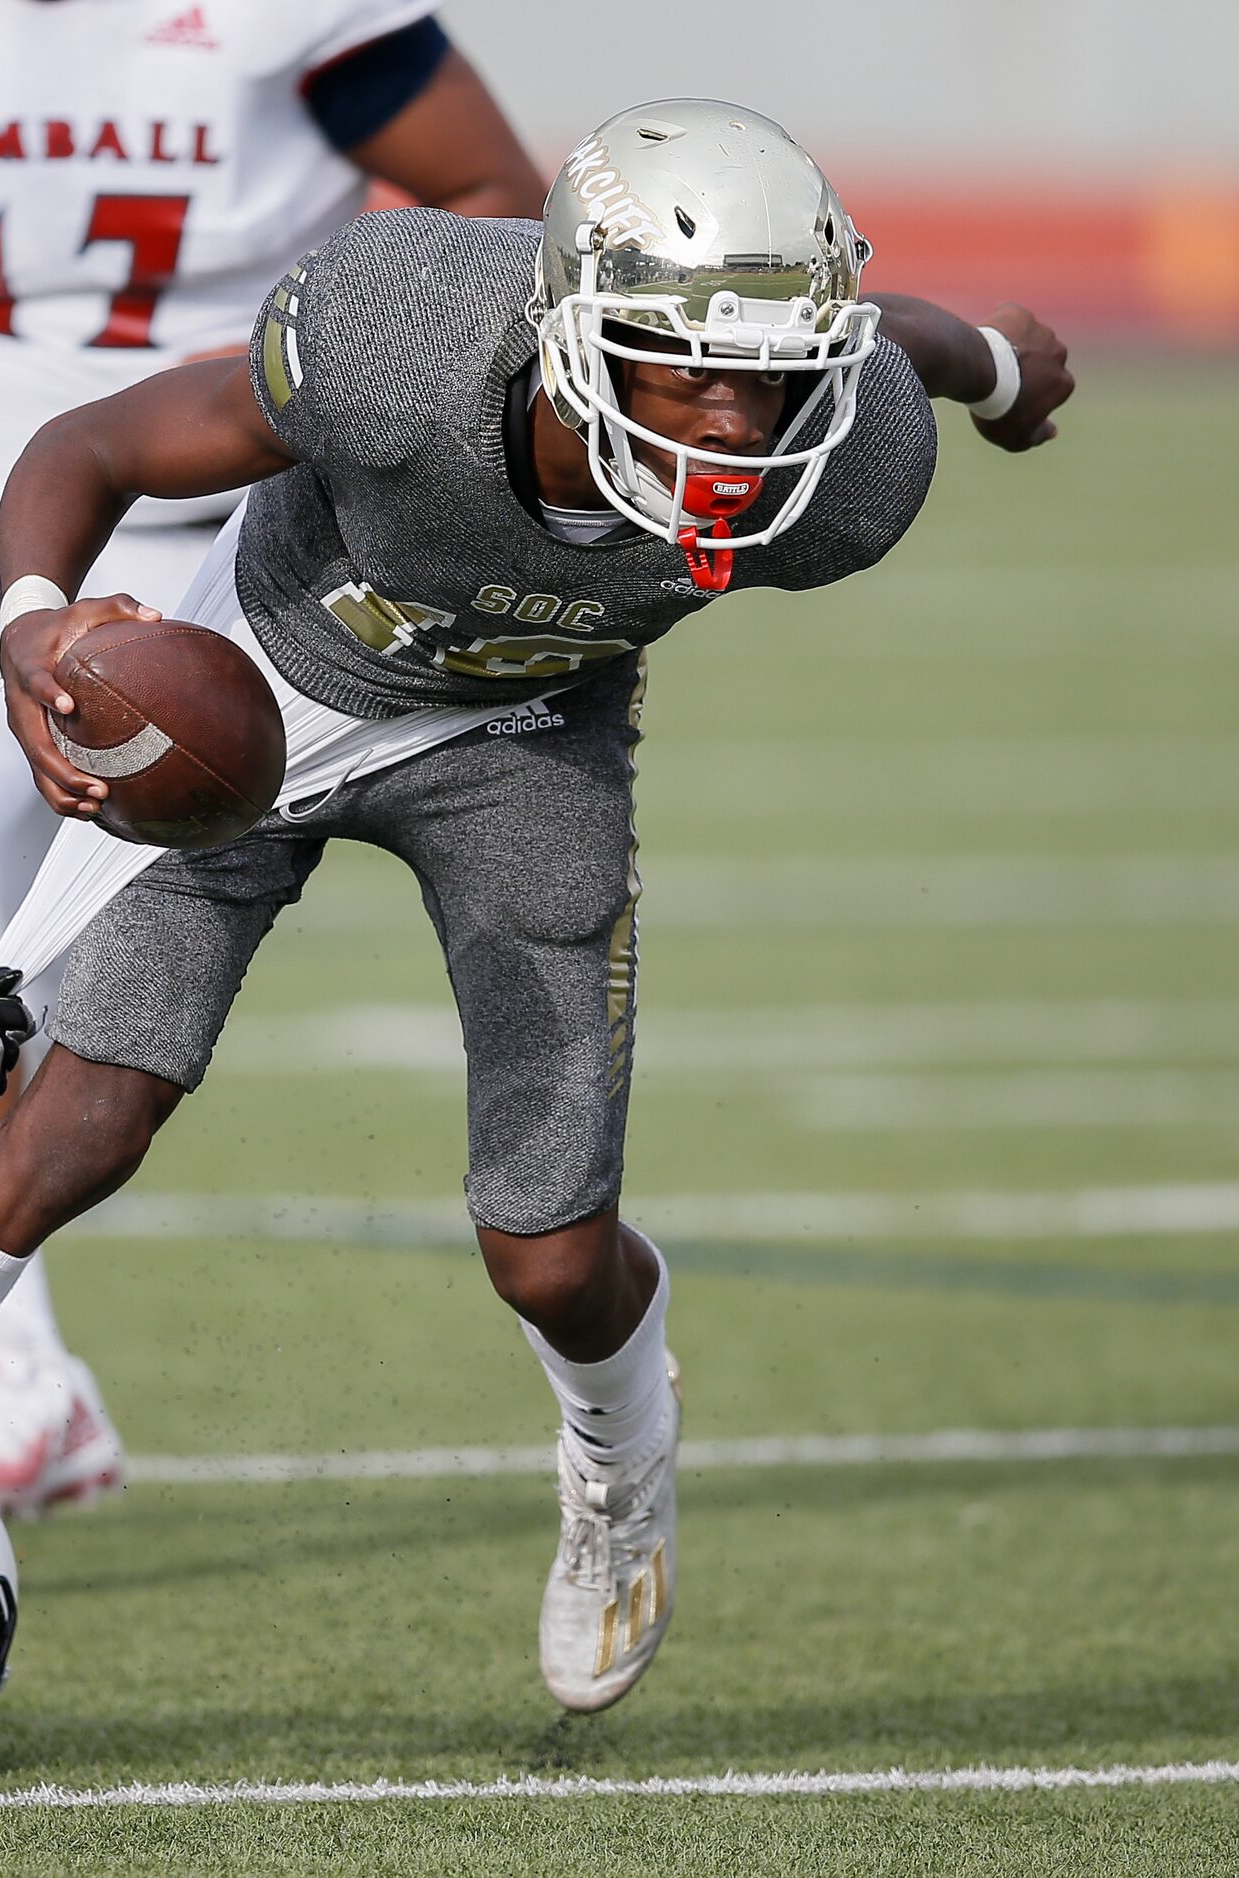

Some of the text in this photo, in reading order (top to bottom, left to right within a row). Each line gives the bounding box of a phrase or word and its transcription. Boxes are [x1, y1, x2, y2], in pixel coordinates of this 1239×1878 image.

[660, 580, 720, 599] adida
[470, 583, 604, 632] SOC
[486, 712, 565, 735] adidas
